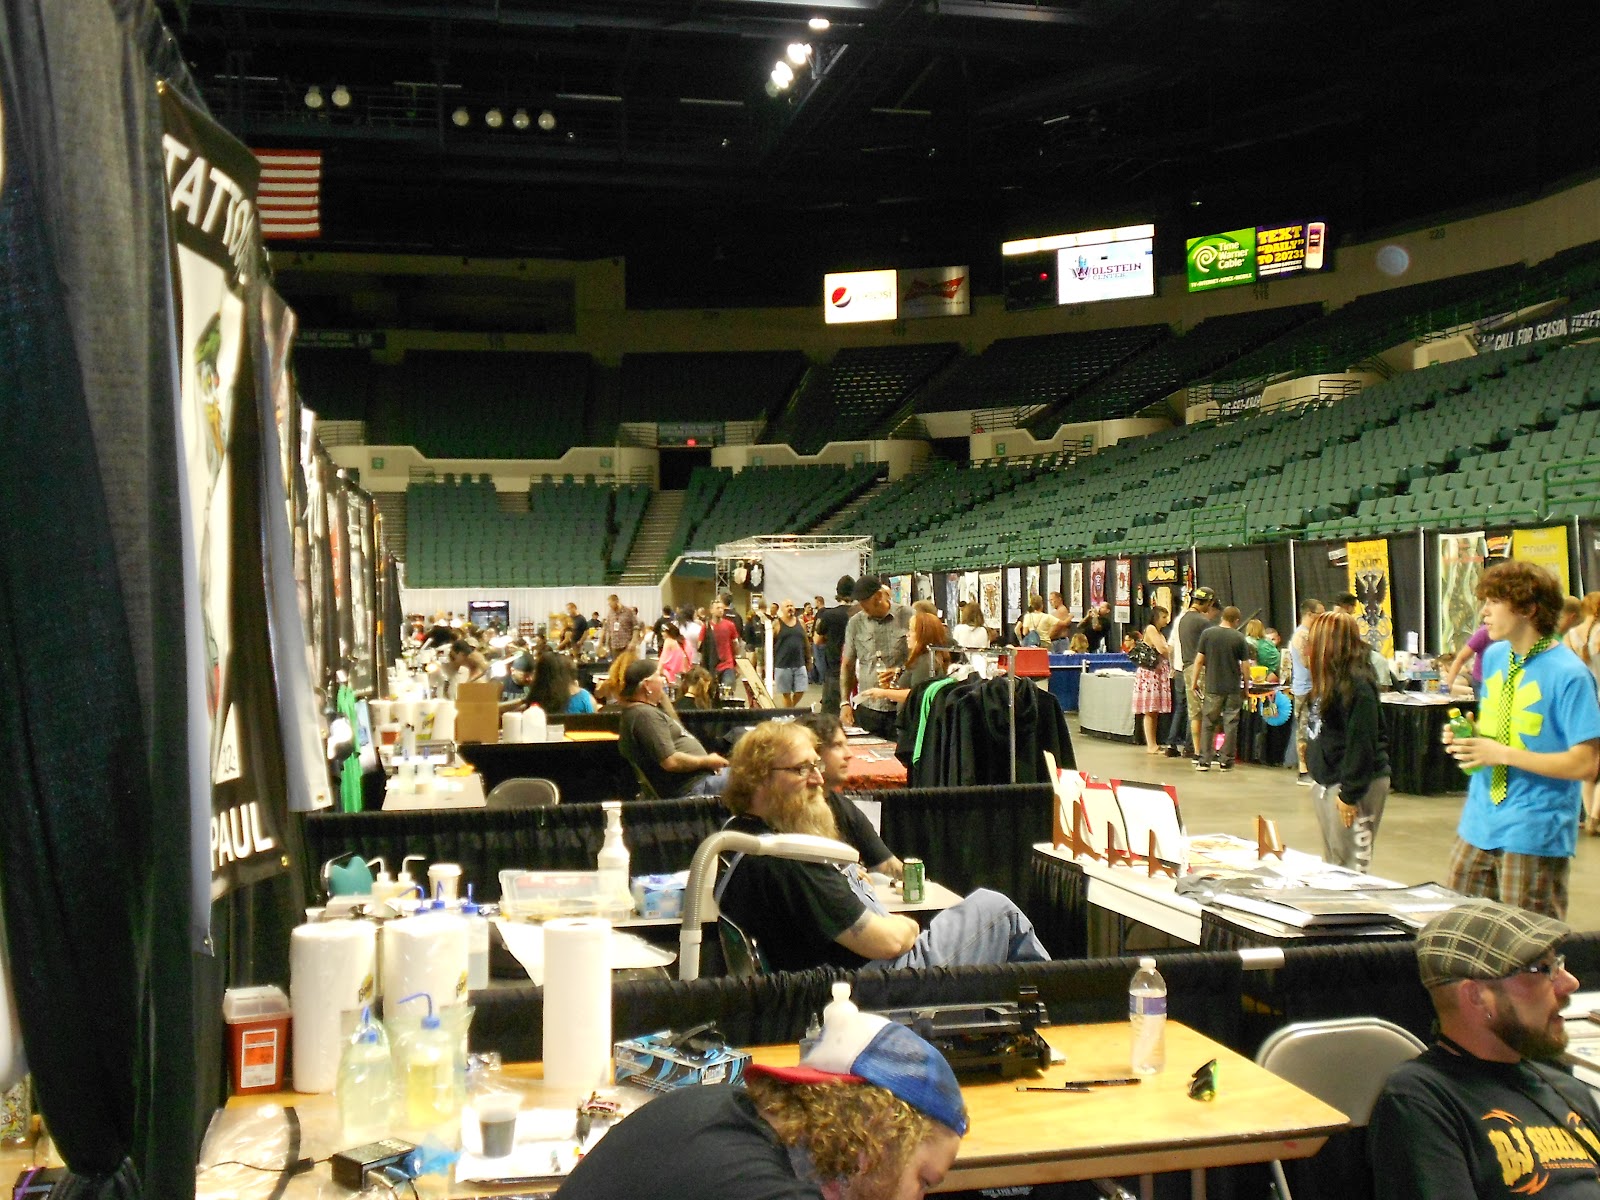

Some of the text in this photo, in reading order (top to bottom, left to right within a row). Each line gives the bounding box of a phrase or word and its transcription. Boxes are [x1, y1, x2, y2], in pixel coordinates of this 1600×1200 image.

[1257, 225, 1302, 244] TEXT
[1219, 242, 1240, 251] Time
[1218, 249, 1249, 260] Warner
[1257, 249, 1305, 265] TO 20731
[1217, 258, 1243, 270] Cable
[1092, 272, 1127, 281] CENTER
[1495, 331, 1514, 351] CALL
[1517, 327, 1533, 346] FOR
[1535, 318, 1567, 341] SEASON
[211, 801, 275, 872] PAUL
